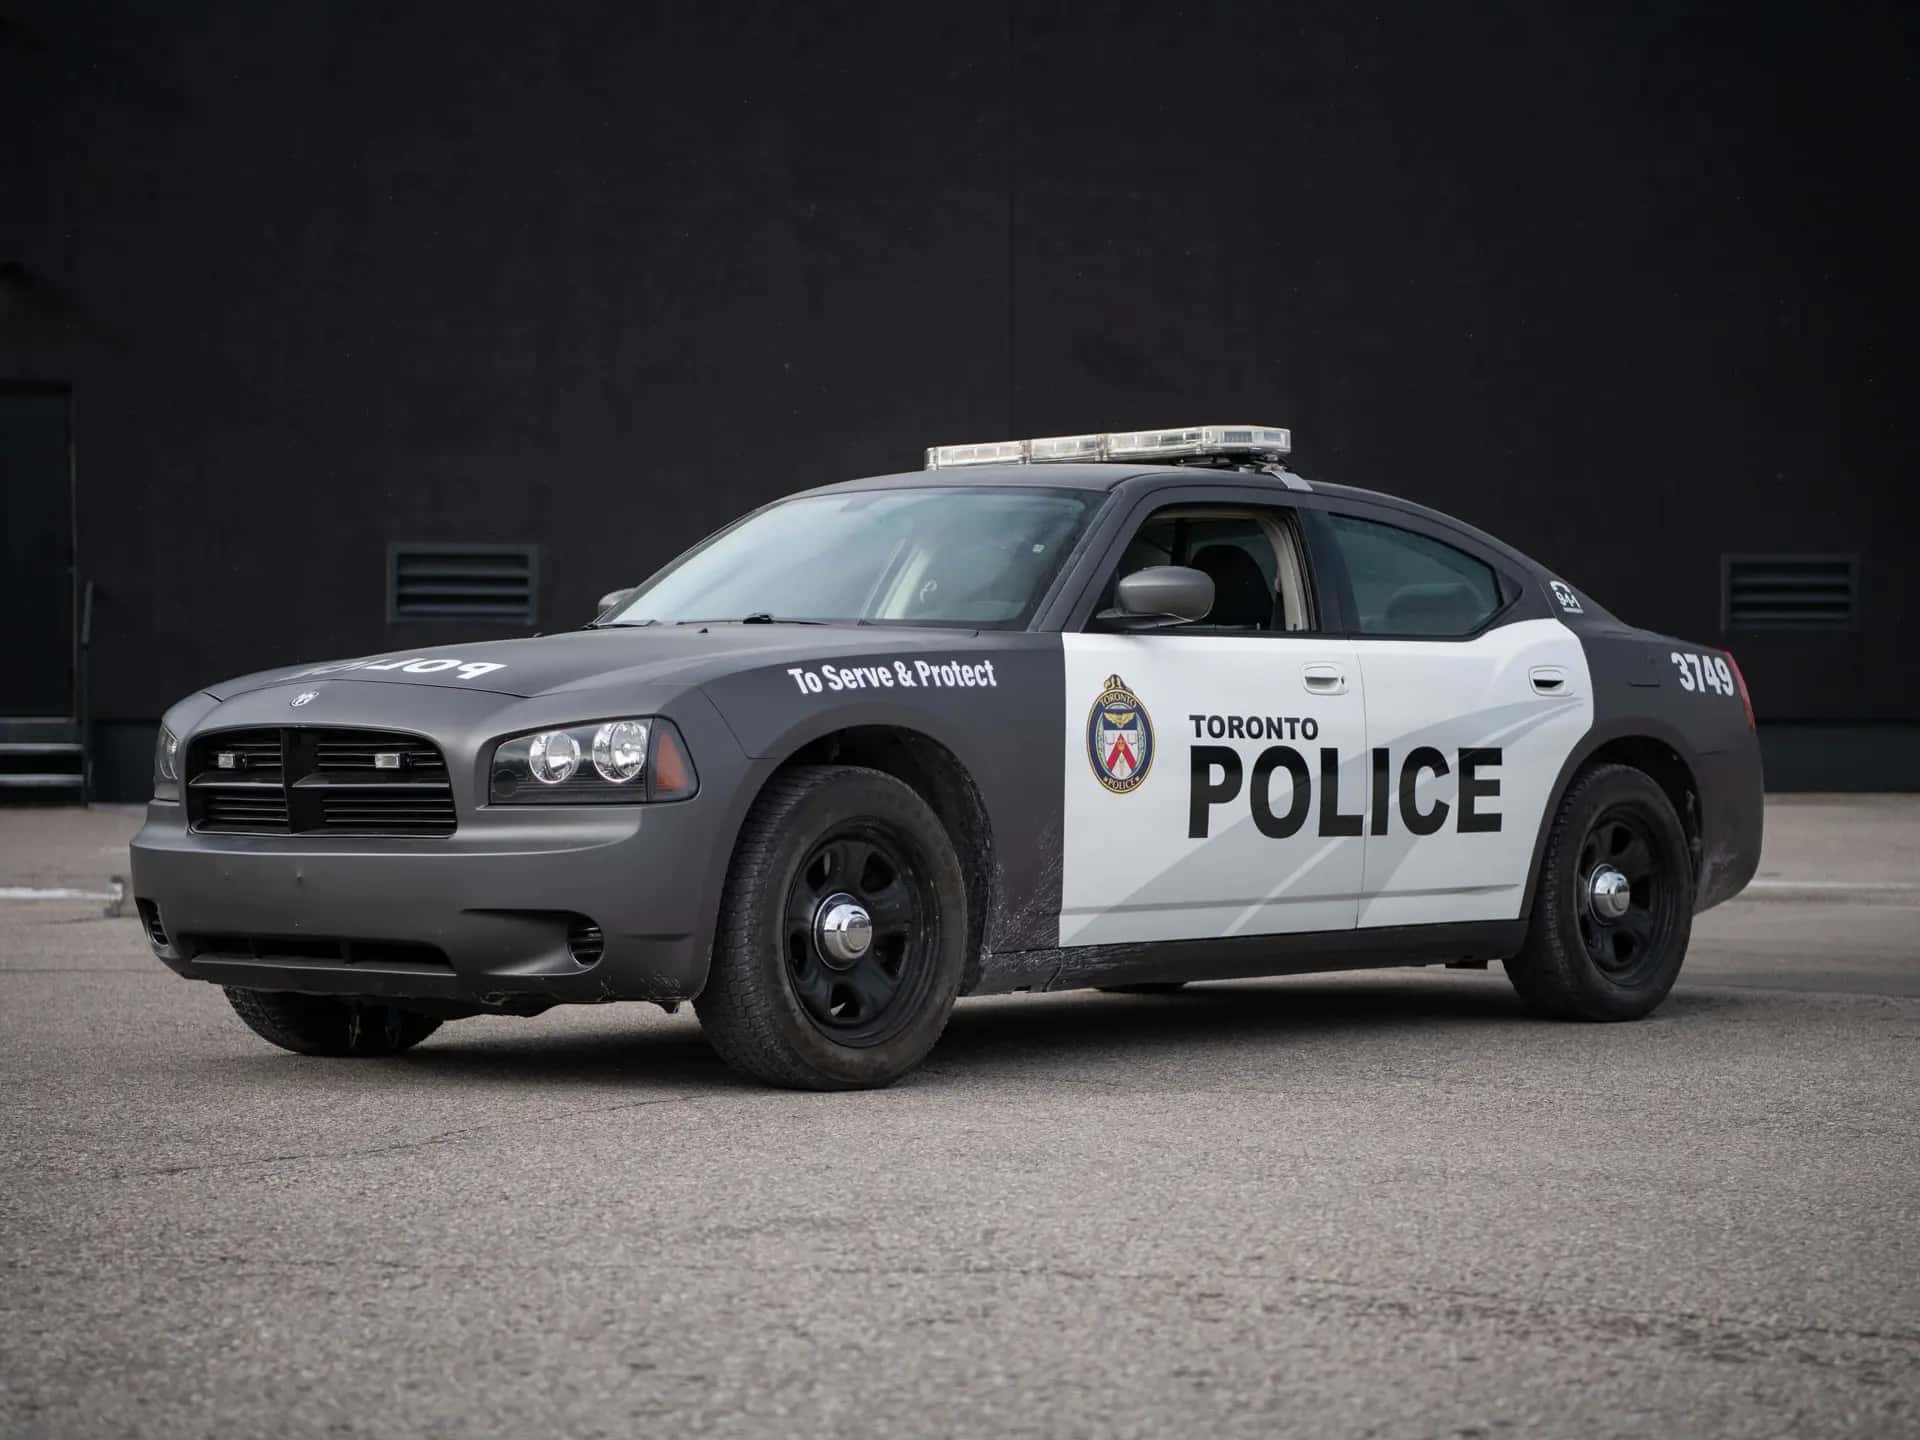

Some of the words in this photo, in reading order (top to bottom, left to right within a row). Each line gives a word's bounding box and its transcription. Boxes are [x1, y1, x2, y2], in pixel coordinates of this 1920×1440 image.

[786, 667, 824, 695] To
[821, 664, 895, 691] Serve
[893, 660, 918, 688] &
[914, 659, 998, 687] Protect
[1670, 651, 1734, 697] 3749
[1100, 692, 1137, 708] TORONTO
[1189, 714, 1319, 741] TORONTO
[1107, 777, 1136, 790] POLICE
[1188, 745, 1503, 839] POLICE
